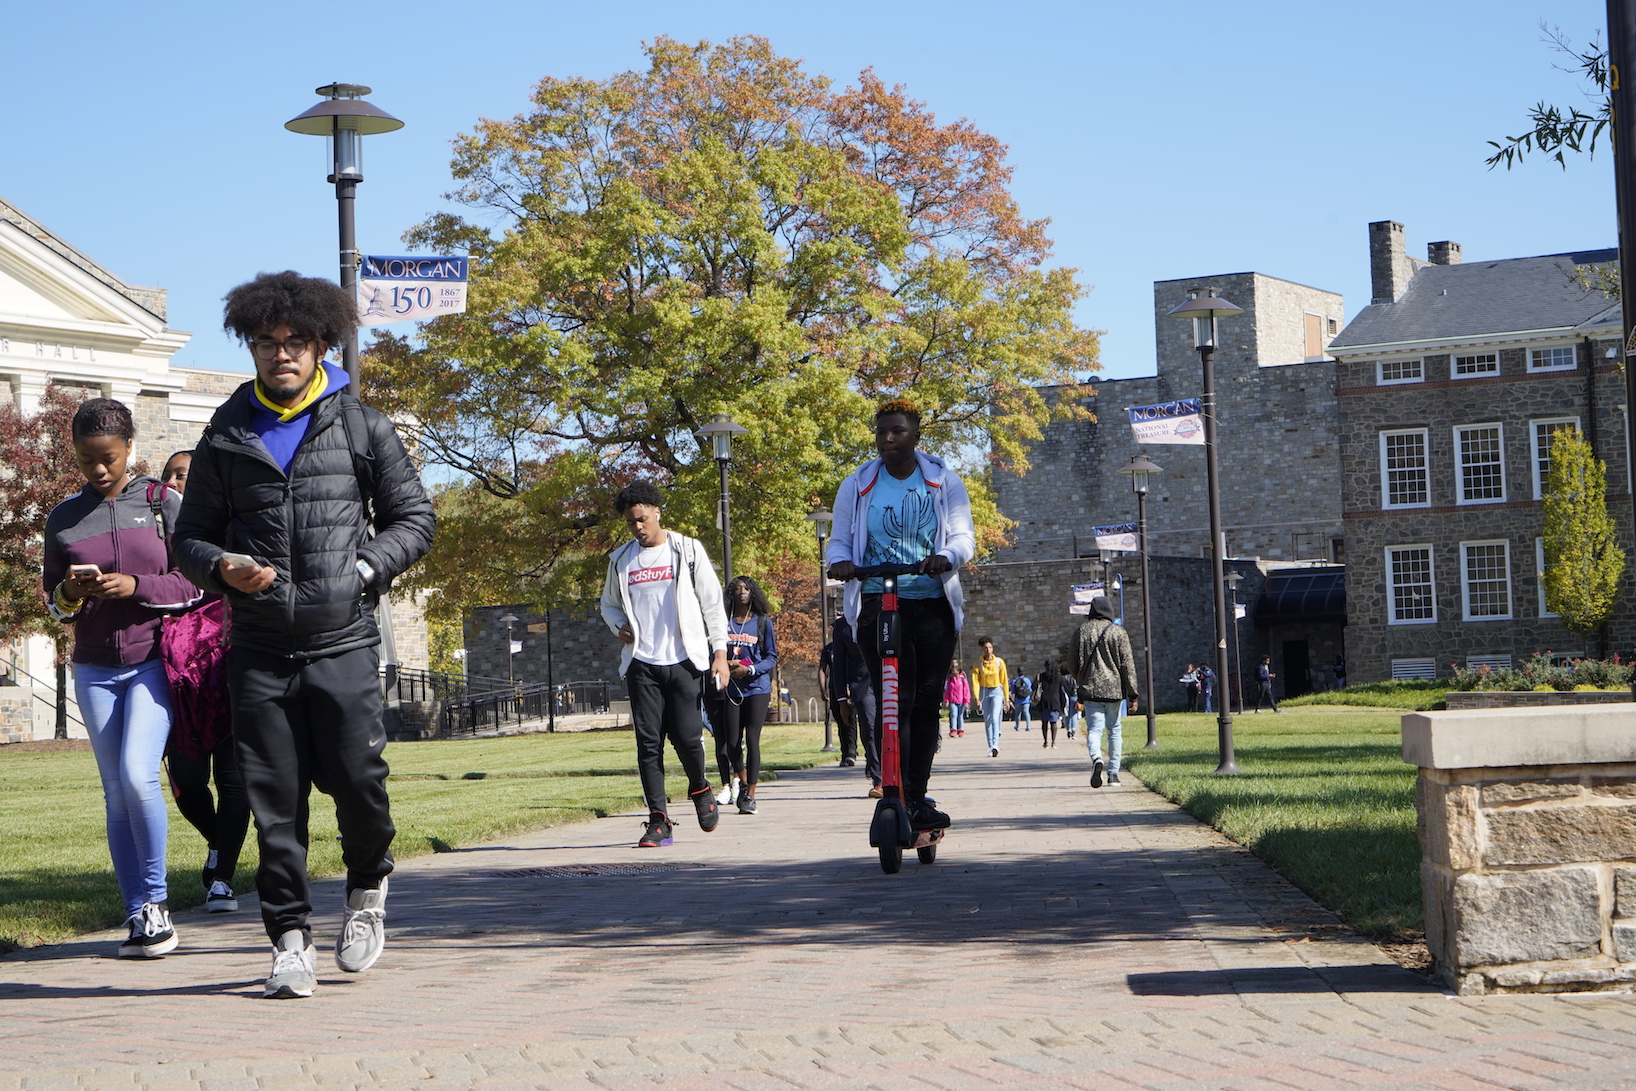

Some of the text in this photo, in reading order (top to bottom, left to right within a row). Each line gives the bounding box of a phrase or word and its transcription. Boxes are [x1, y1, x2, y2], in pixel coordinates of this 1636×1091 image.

[369, 259, 462, 278] MORGAN
[390, 285, 434, 315] 150
[440, 288, 460, 296] 1867
[35, 342, 96, 361] HALL
[1133, 400, 1194, 421] MORGAN
[1135, 423, 1169, 433] NATIONAL
[1136, 430, 1169, 439] TREASURE
[628, 567, 673, 583] edStuyF
[883, 665, 898, 730] JUMP
